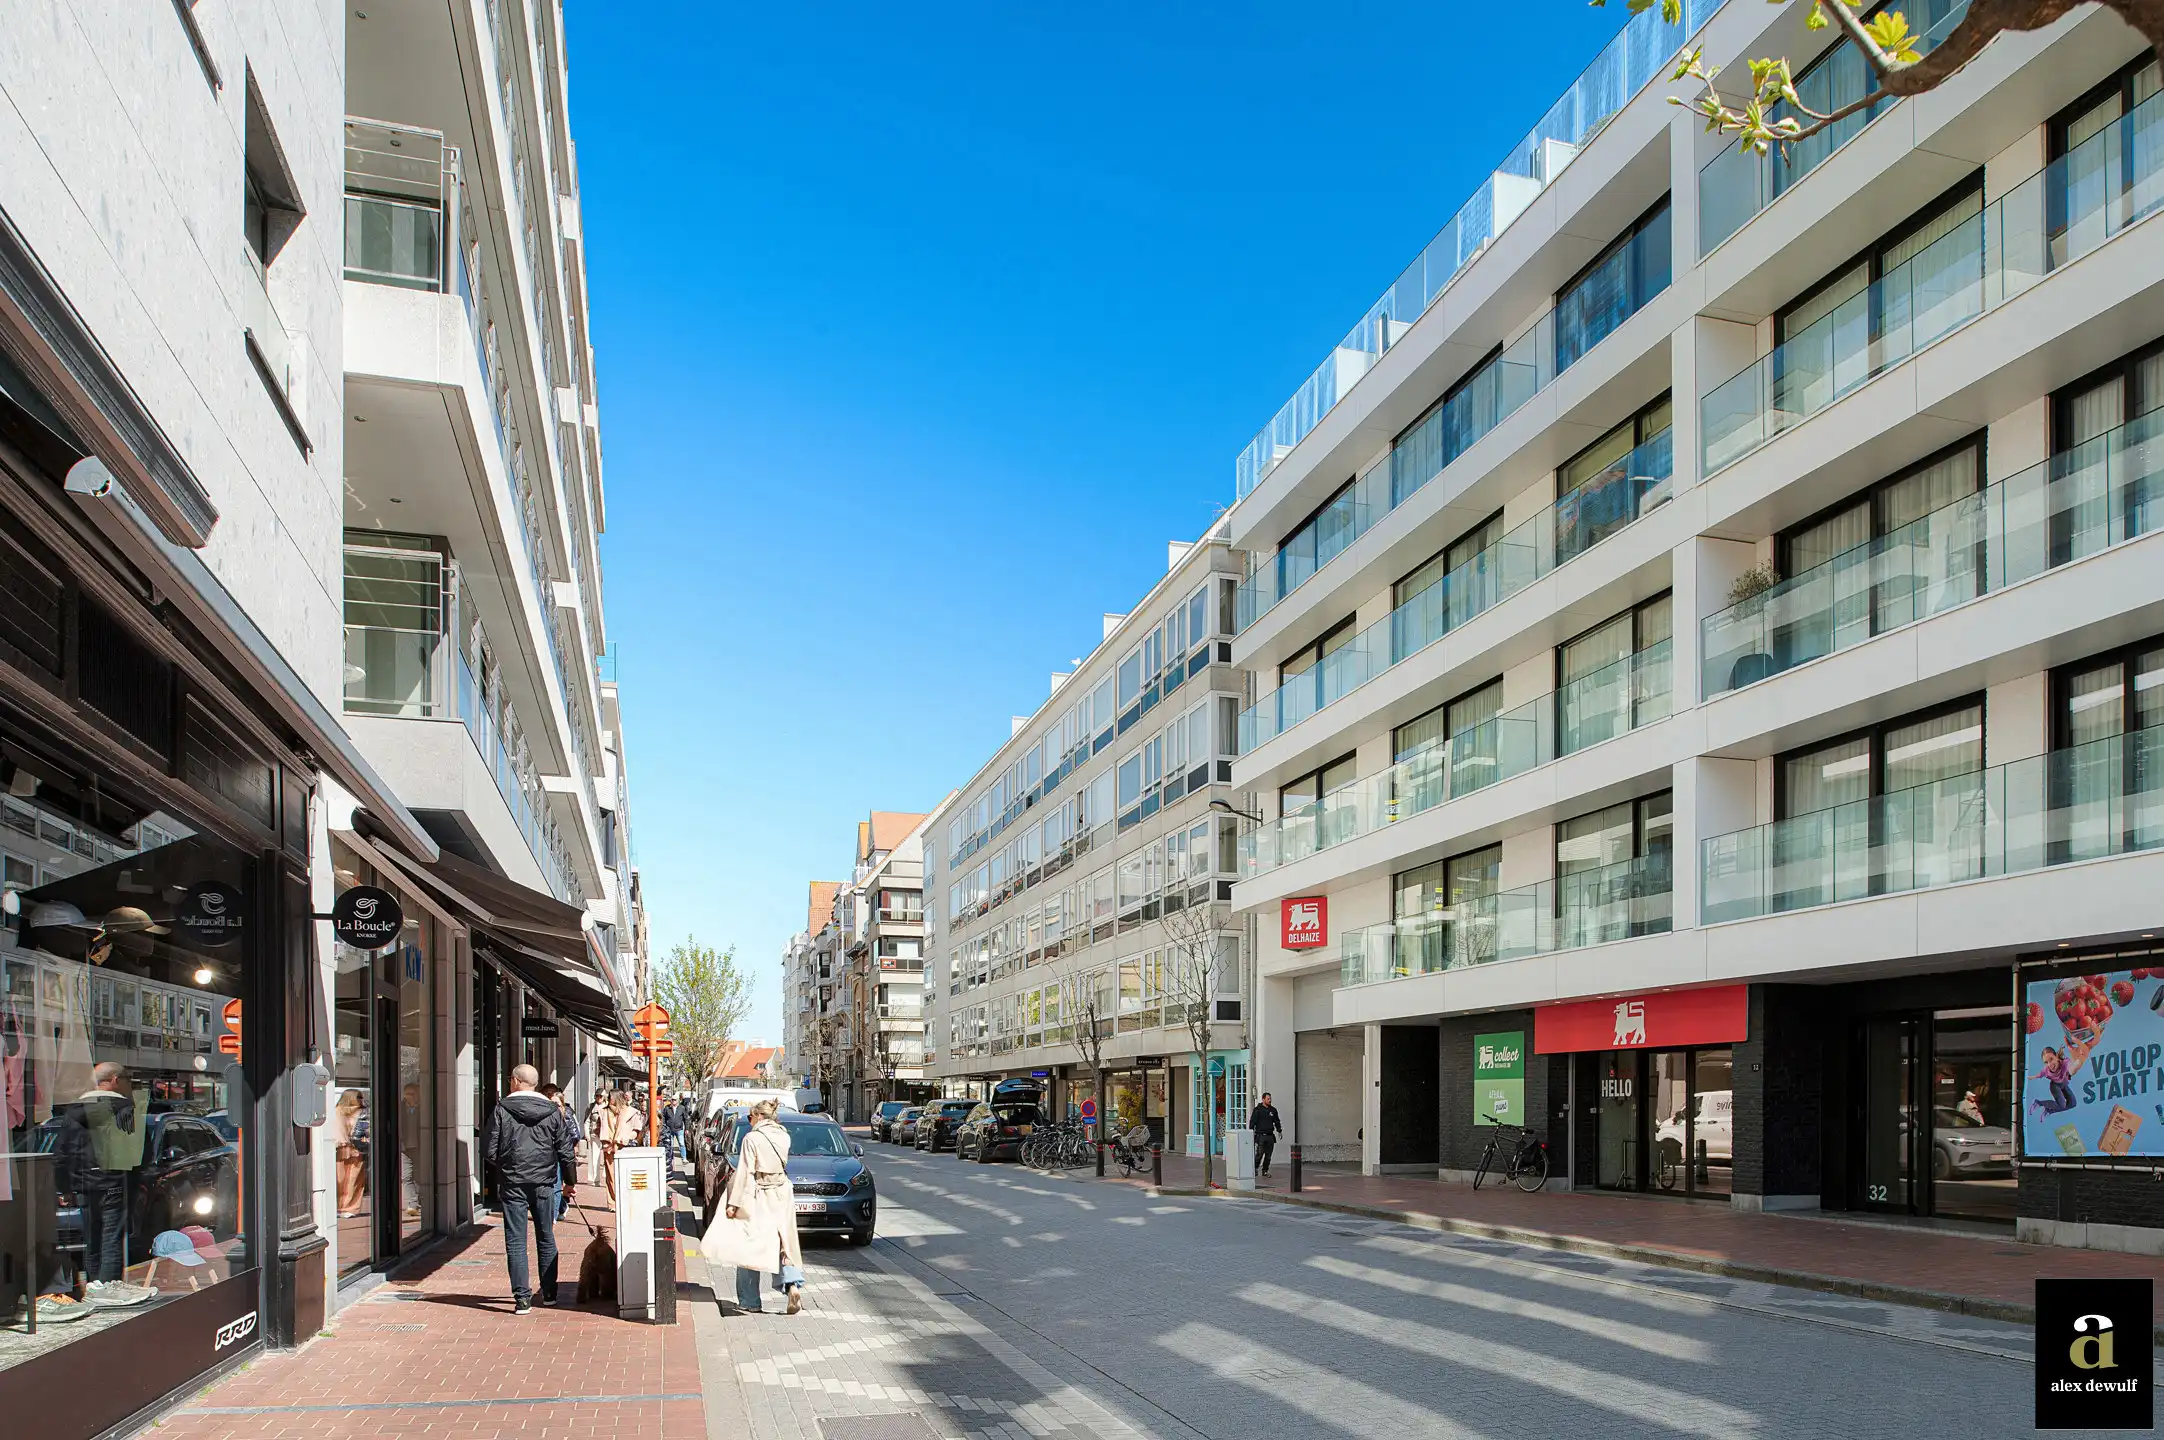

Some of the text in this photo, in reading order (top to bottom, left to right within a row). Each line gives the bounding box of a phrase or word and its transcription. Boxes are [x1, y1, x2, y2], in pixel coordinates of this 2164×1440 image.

[338, 920, 352, 930] La
[1289, 932, 1320, 943] DELHAIZE
[1494, 1046, 1520, 1062] collect
[2091, 1043, 2161, 1079] VOLOP
[1601, 1078, 1632, 1097] HELLO
[2082, 1069, 2151, 1105] START
[1869, 1184, 1887, 1201] 32
